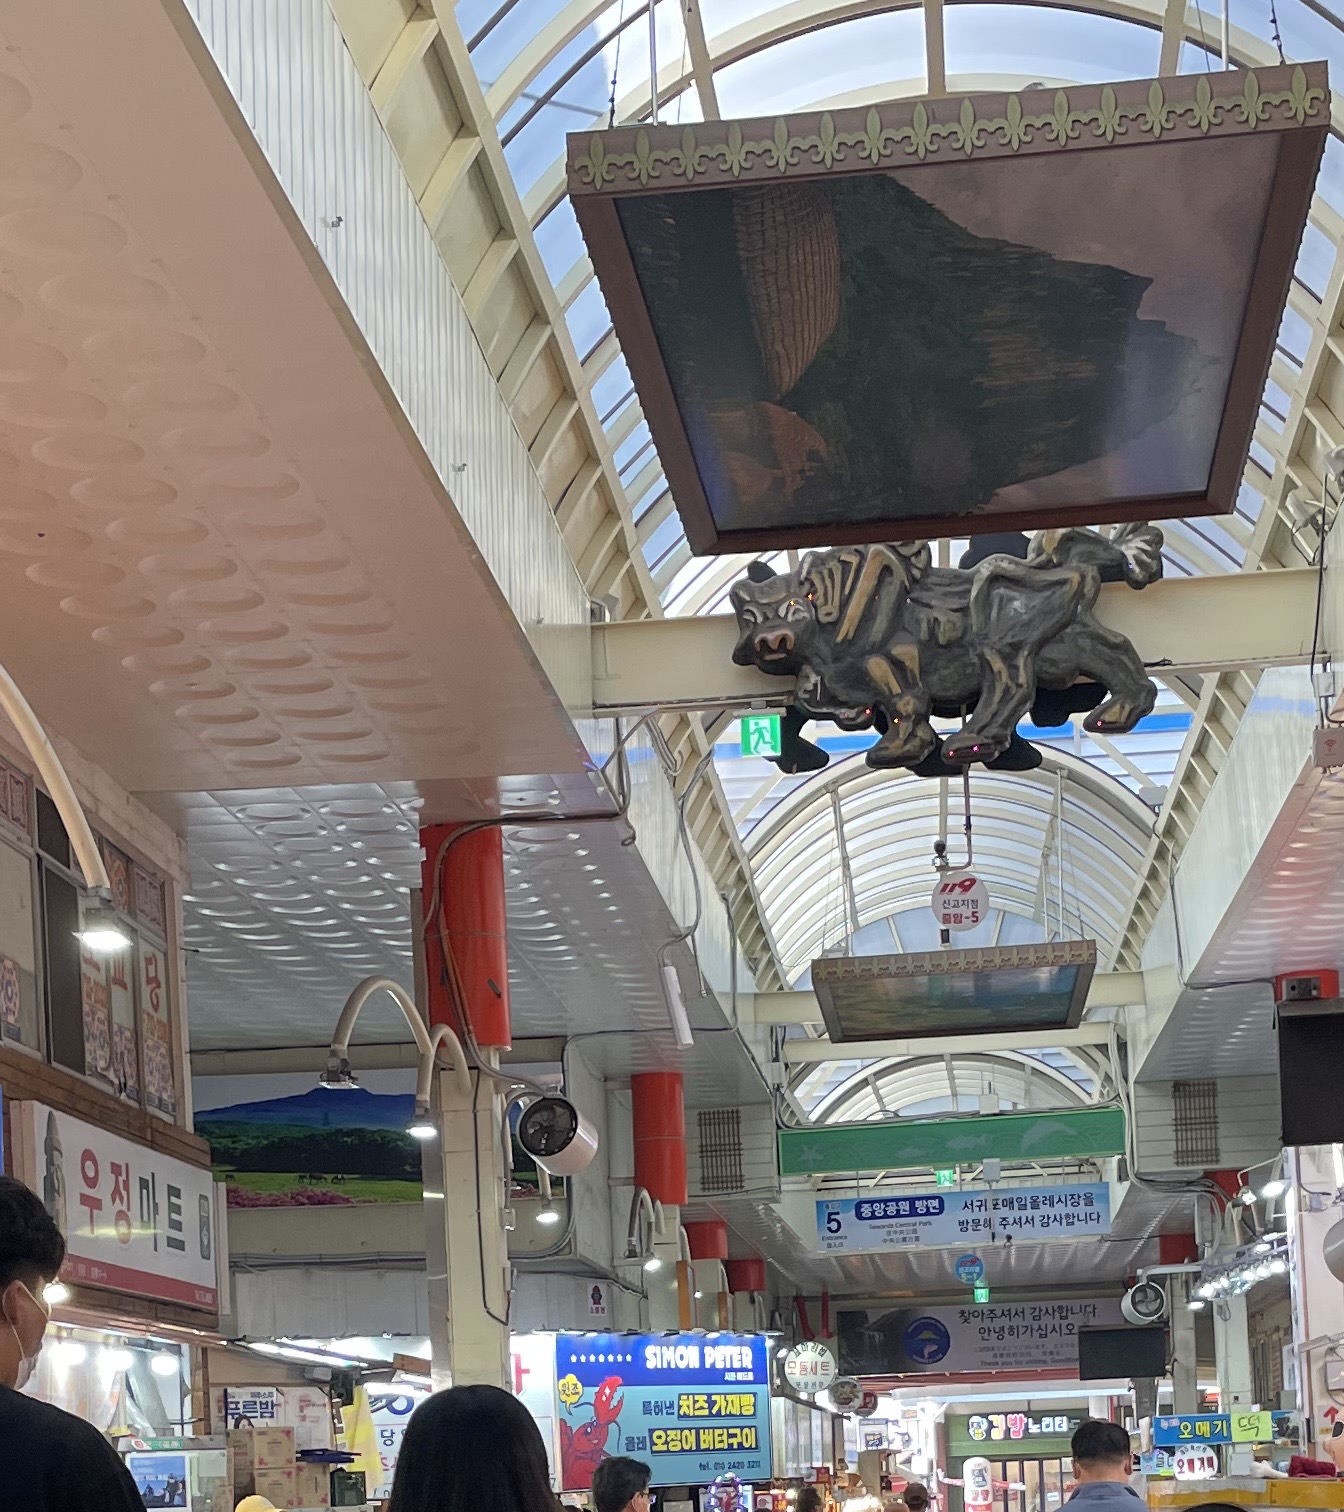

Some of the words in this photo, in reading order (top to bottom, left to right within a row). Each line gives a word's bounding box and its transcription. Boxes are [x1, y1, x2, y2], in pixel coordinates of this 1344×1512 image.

[938, 877, 977, 895] 119
[78, 1147, 186, 1253] 우정마트
[826, 1211, 842, 1234] 5
[860, 1201, 911, 1218] 중앙공원
[915, 1198, 940, 1214] 방면
[999, 1214, 1036, 1230] 주셔서
[1039, 1210, 1102, 1229] 감사합니다
[958, 1305, 1026, 1324] 찾아주셔서
[1029, 1303, 1097, 1321] 감사합니다
[978, 1322, 1078, 1342] 안녕히가십시오
[645, 1345, 700, 1369] SIMON
[704, 1345, 753, 1369] PETER
[679, 1394, 709, 1416] 치즈
[711, 1393, 755, 1416] 가재빵
[652, 1429, 697, 1452] 오징어
[699, 1427, 756, 1450] 버터구이
[1177, 1419, 1228, 1439] 오메기
